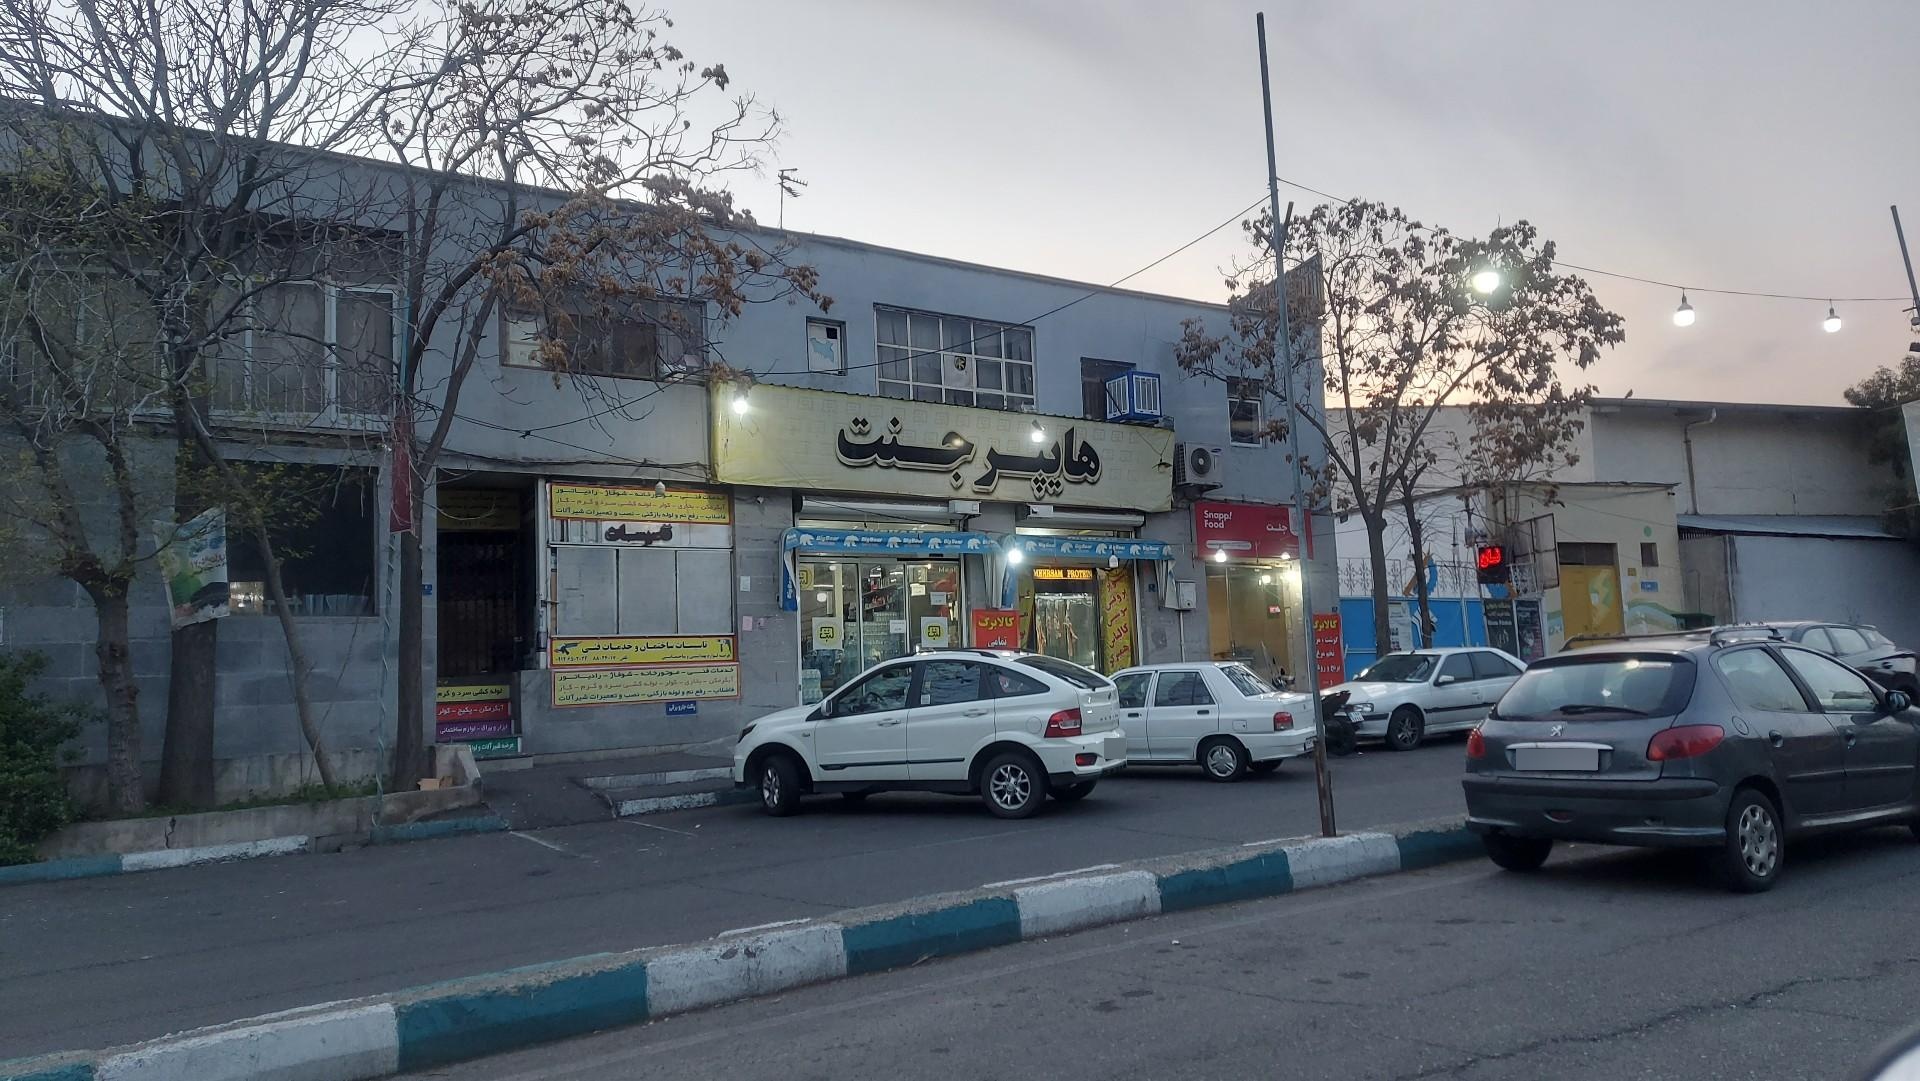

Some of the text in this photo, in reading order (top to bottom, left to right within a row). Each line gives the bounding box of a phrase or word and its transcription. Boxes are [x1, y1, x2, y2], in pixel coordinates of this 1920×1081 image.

[835, 416, 1103, 500] هایپر جنت
[635, 491, 673, 499] موورخانه
[1203, 510, 1233, 521] Snapp!
[1204, 520, 1225, 529] Food
[1266, 522, 1288, 535] جنت
[1067, 570, 1093, 578] PROTEIN
[582, 643, 600, 653] فنی
[559, 673, 602, 681] رادیاتور
